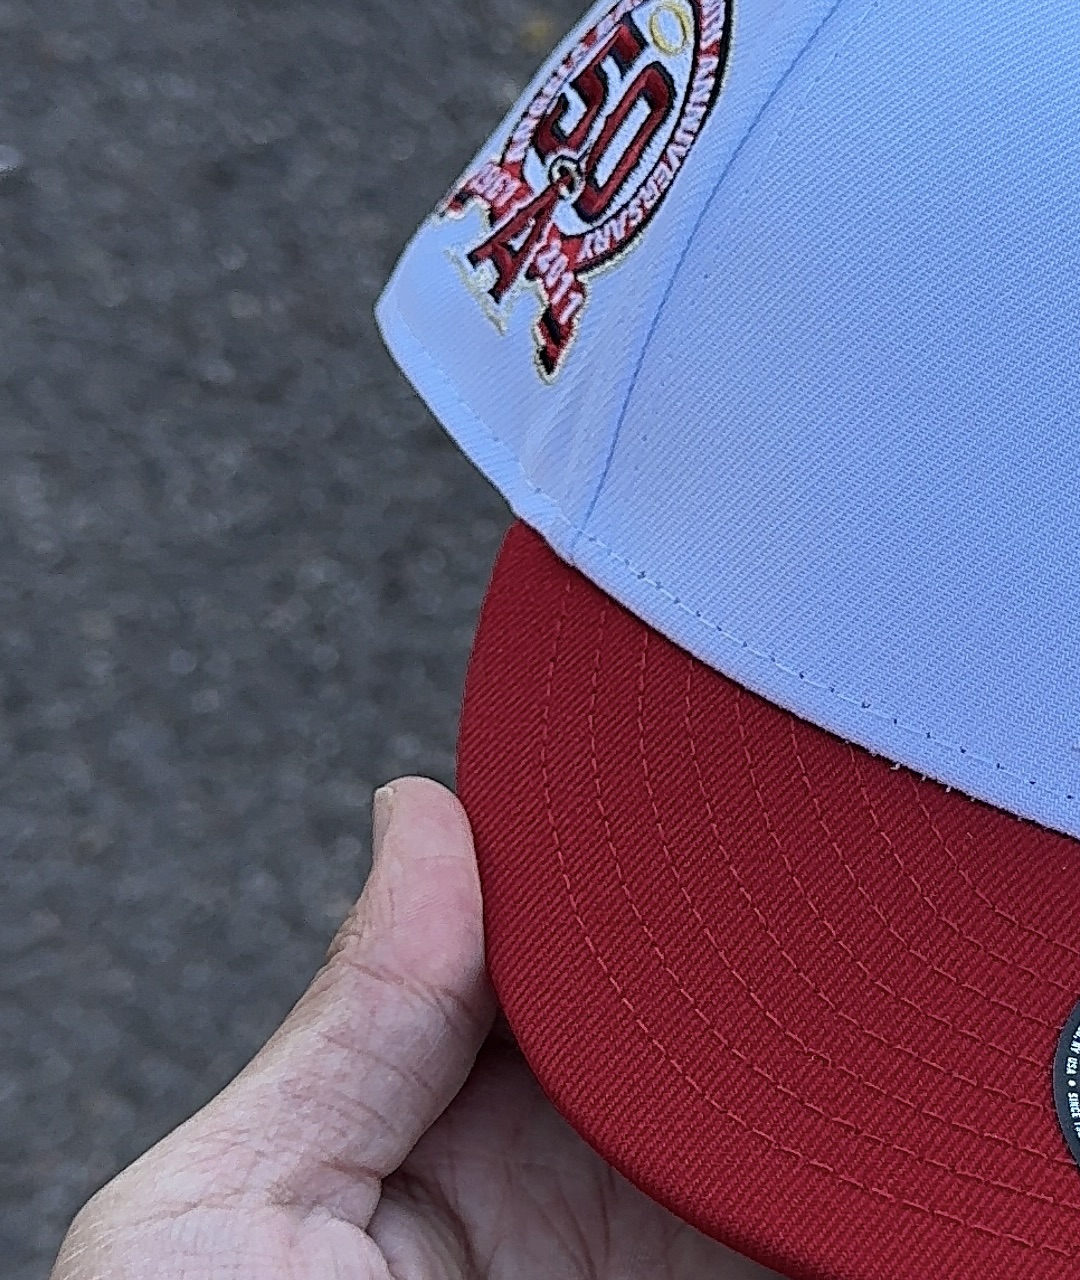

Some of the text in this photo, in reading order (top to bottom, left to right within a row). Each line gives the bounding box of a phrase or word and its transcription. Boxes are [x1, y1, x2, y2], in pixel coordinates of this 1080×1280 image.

[530, 20, 674, 224] 50
[581, 55, 720, 259] ANNIVERSARY
[538, 241, 583, 324] 2011
[1067, 1056, 1078, 1075] USA
